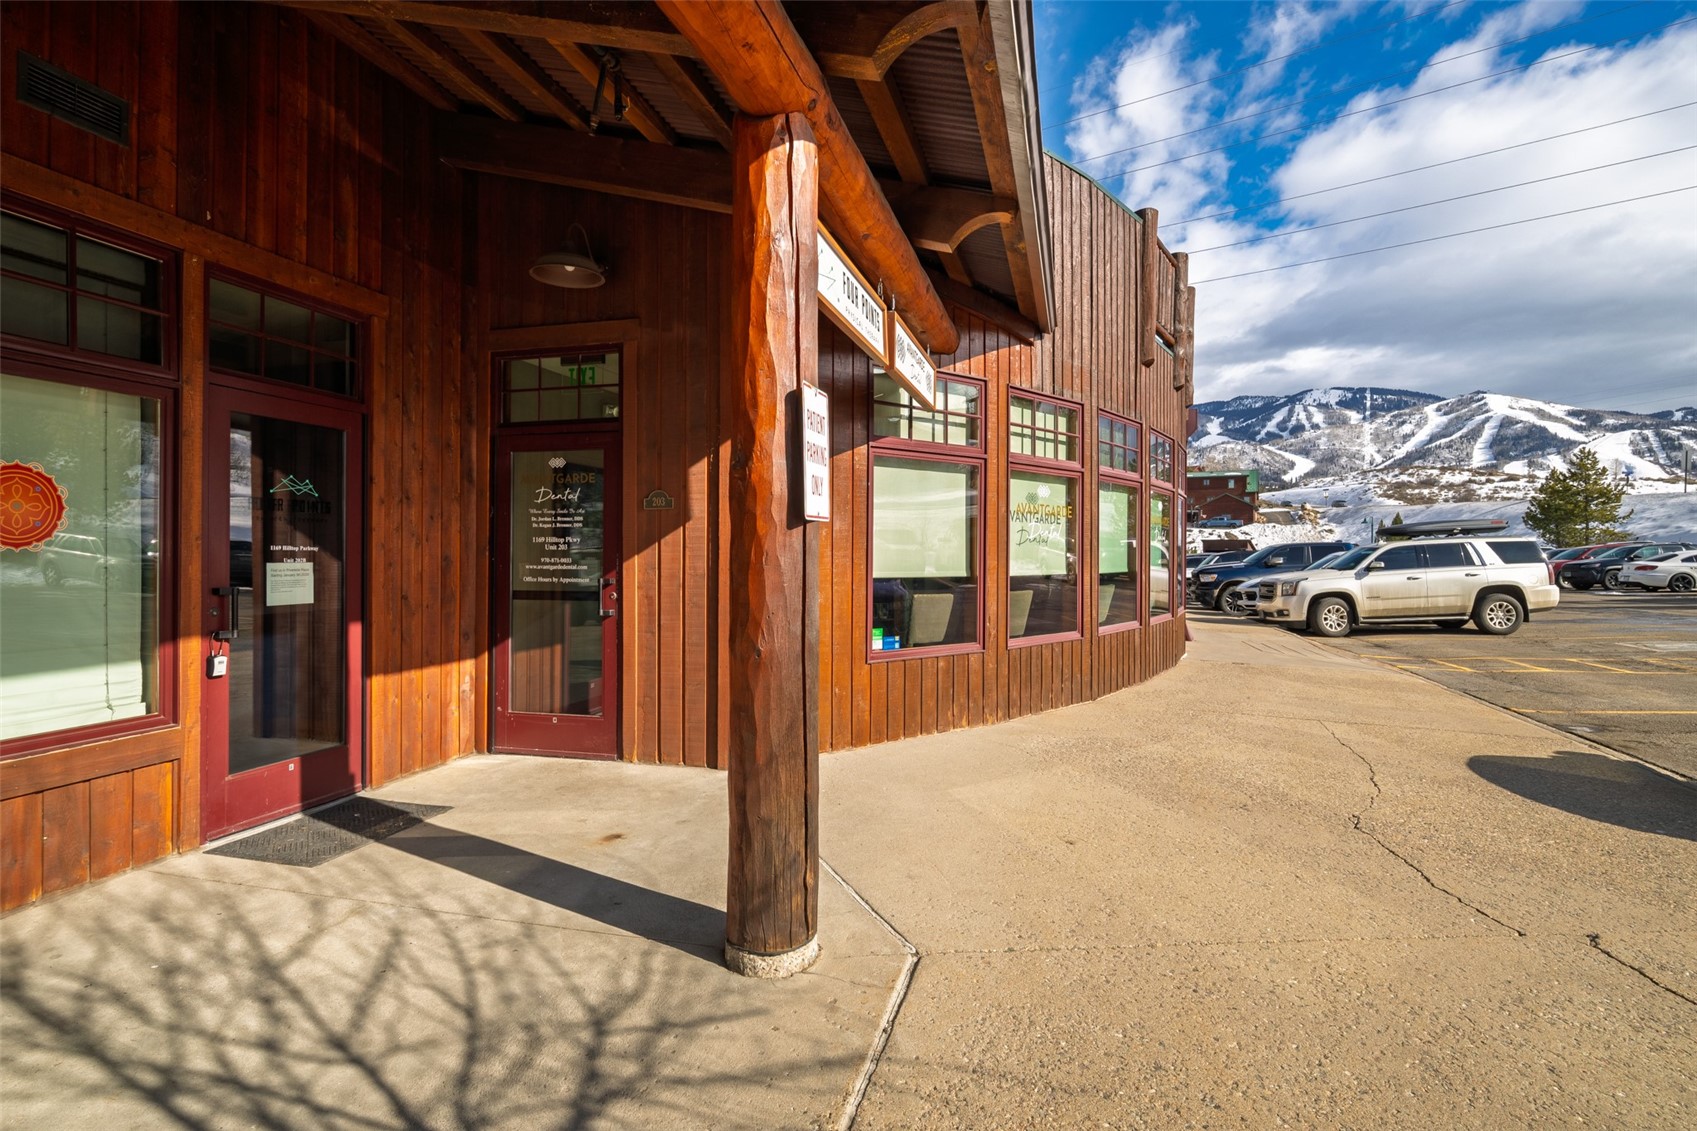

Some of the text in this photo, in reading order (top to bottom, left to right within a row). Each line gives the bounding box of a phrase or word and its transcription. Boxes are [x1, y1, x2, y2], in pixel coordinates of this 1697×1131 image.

[842, 272, 880, 332] FOUR POINTS
[807, 408, 826, 436] PATIENT
[807, 440, 827, 467] PARKING
[534, 486, 581, 503] Dental
[812, 474, 824, 496] ONLY
[652, 496, 665, 506] 203
[1016, 503, 1073, 518] AVANTGARDE
[1028, 522, 1063, 540] Dental
